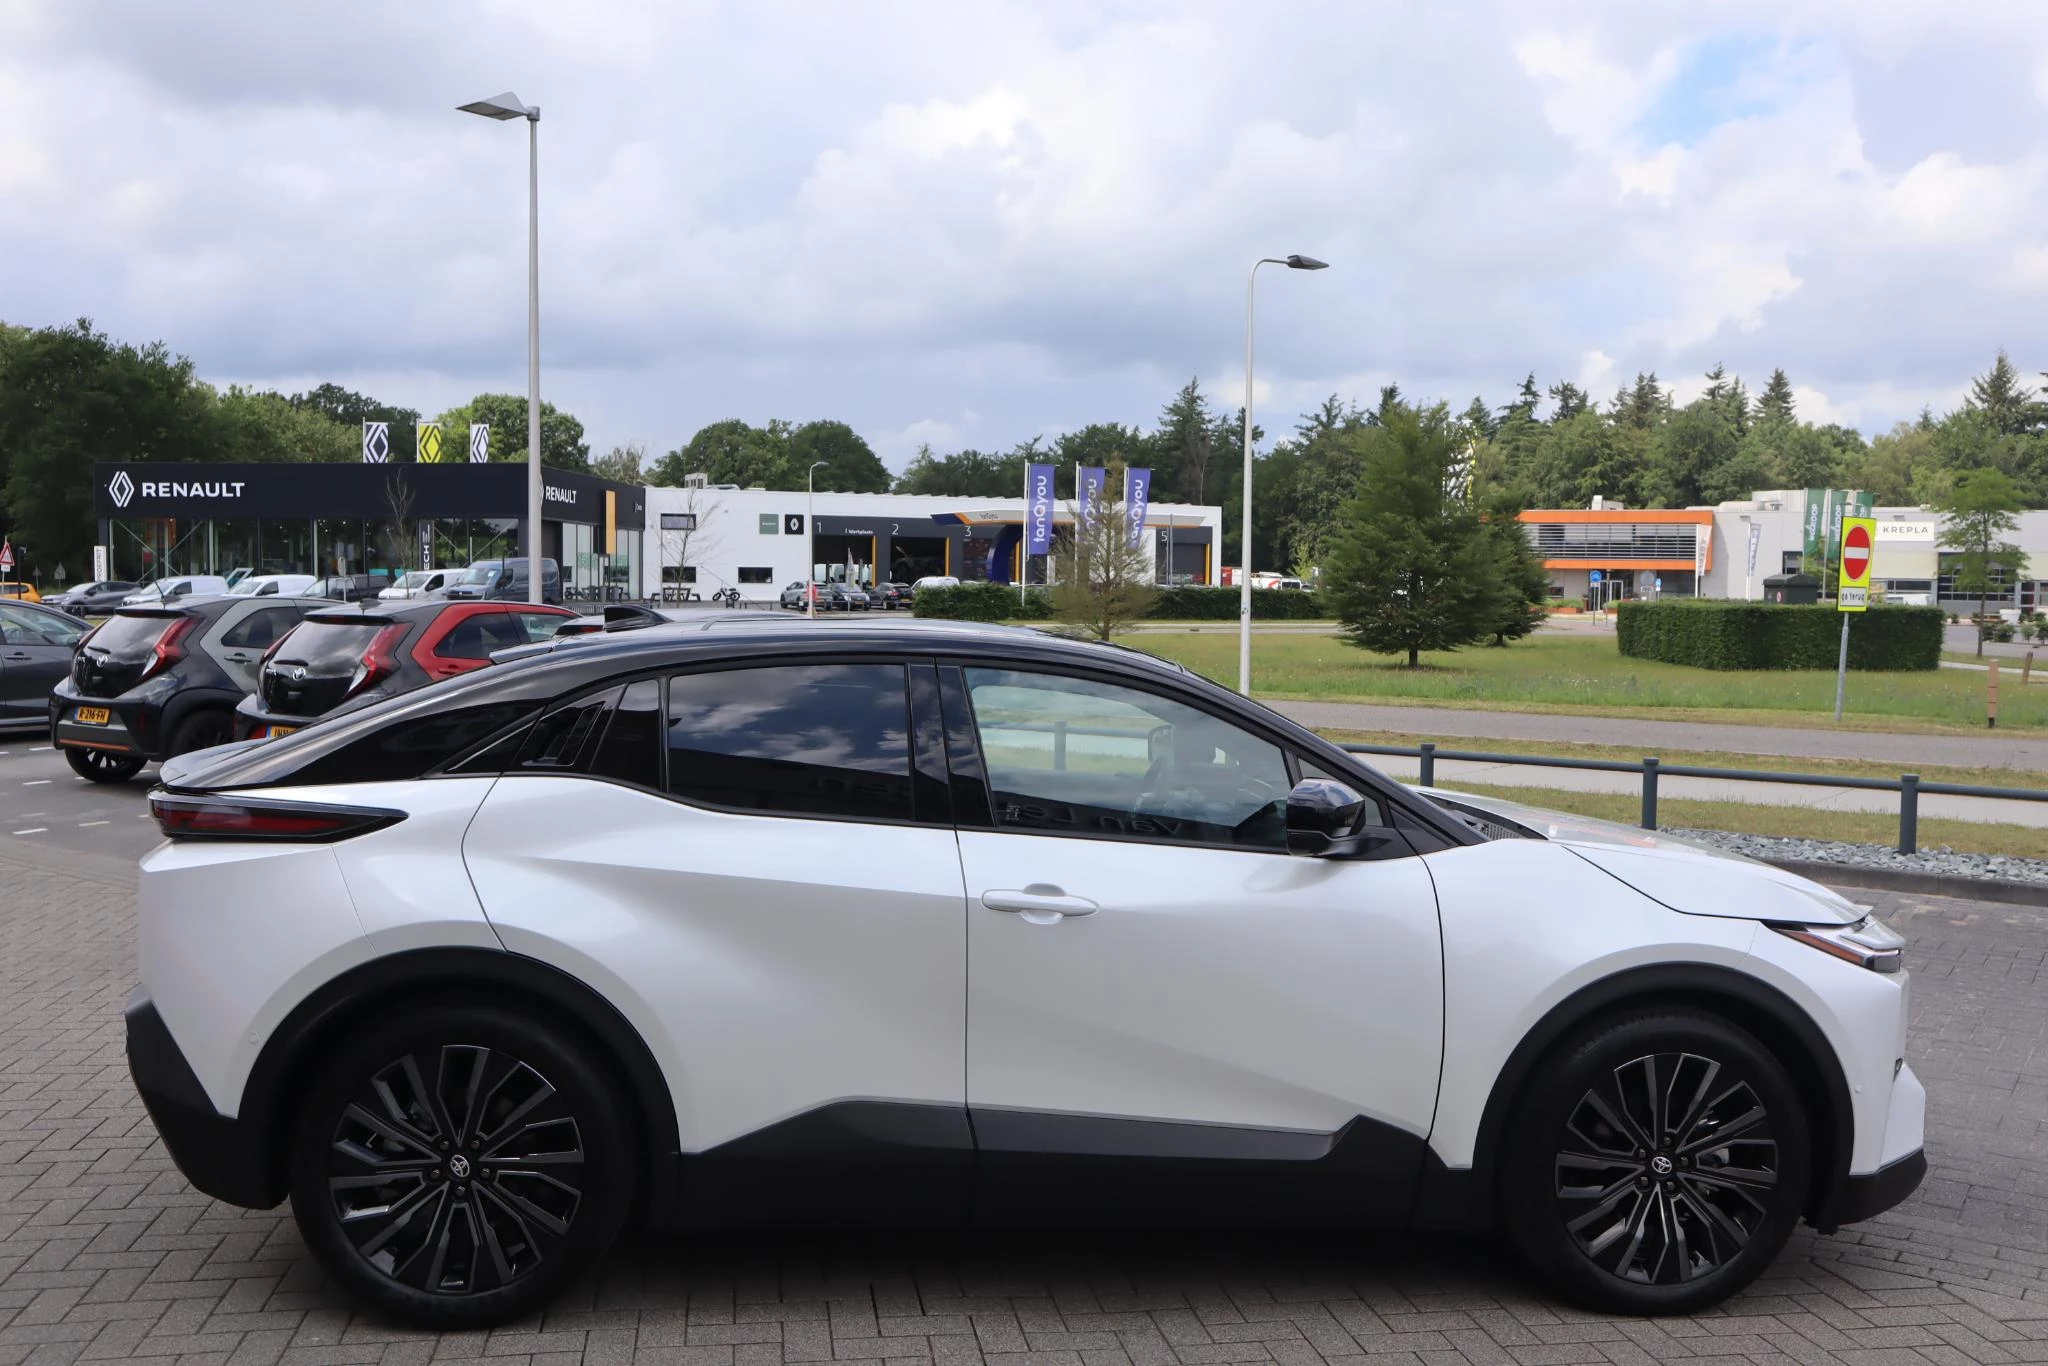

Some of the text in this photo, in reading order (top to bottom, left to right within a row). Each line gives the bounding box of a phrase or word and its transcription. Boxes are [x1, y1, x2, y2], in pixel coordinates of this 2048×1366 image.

[142, 482, 245, 498] RENAULT
[545, 485, 577, 504] RENAULT
[1033, 475, 1049, 543] tanQyou
[817, 522, 822, 533] 1
[892, 524, 899, 535] 2
[964, 526, 972, 537] 3
[1883, 526, 1929, 534] KREPLA
[1161, 531, 1168, 542] 5
